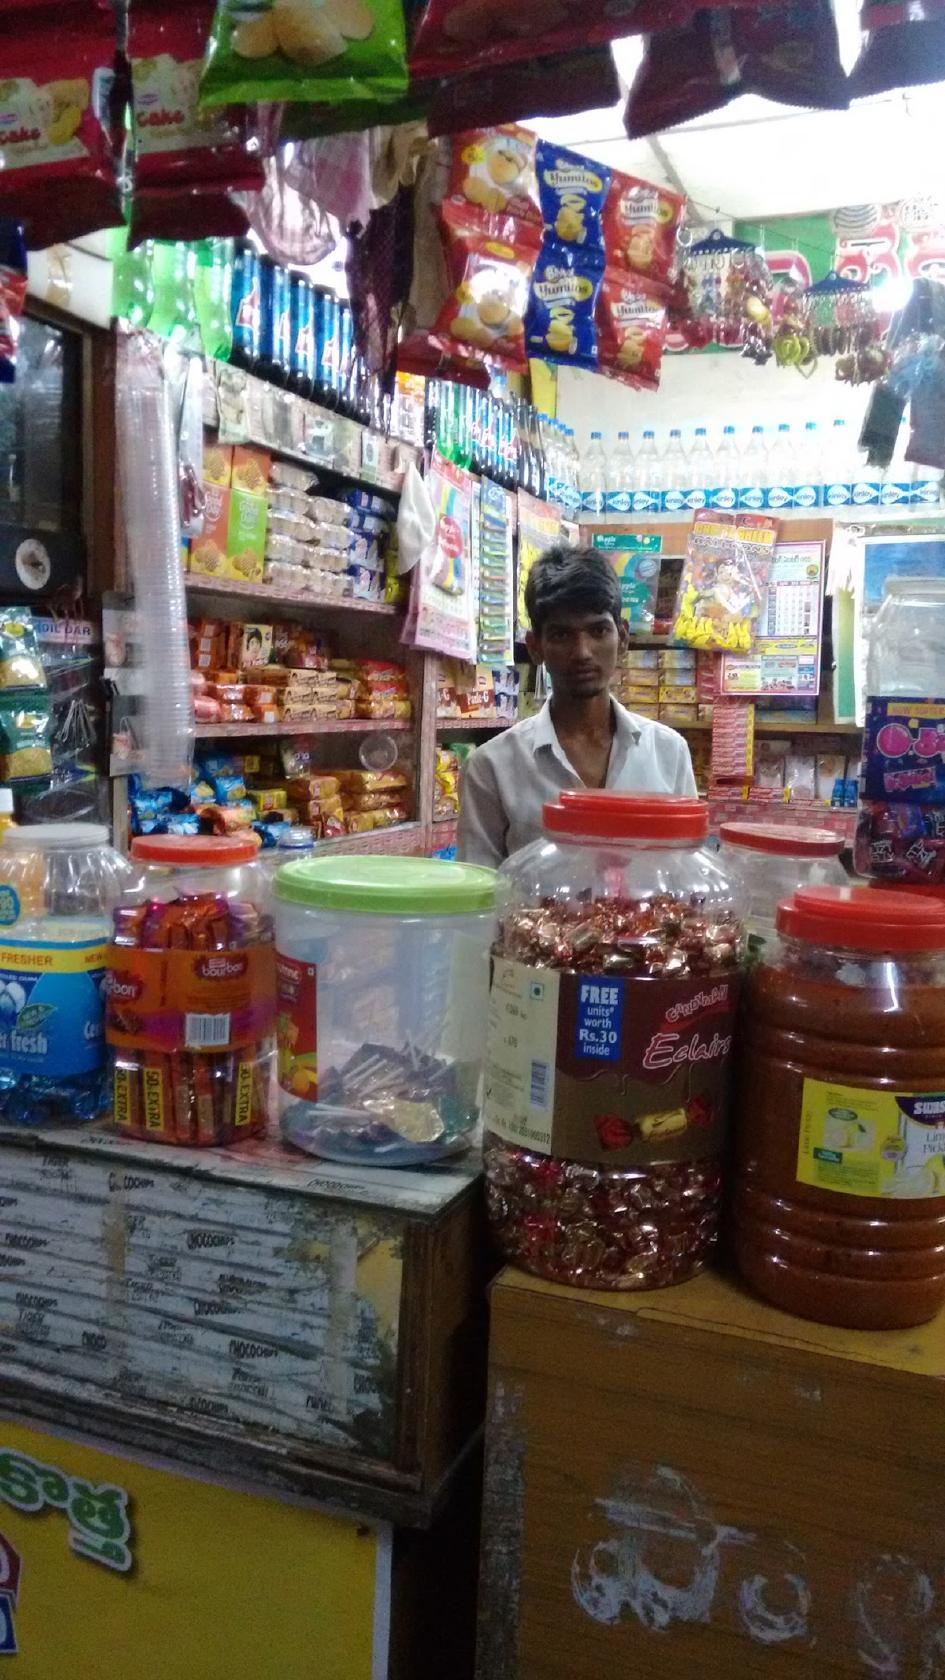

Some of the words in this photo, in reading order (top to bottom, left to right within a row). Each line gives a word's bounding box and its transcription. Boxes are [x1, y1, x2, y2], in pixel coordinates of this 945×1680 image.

[1, 952, 53, 966] FRESHER
[580, 984, 619, 1005] FREE
[584, 1017, 612, 1030] worth
[11, 1029, 48, 1055] fresh
[579, 1028, 618, 1044] Rs.30
[583, 1043, 611, 1056] inside
[642, 1031, 733, 1070] Eclairs
